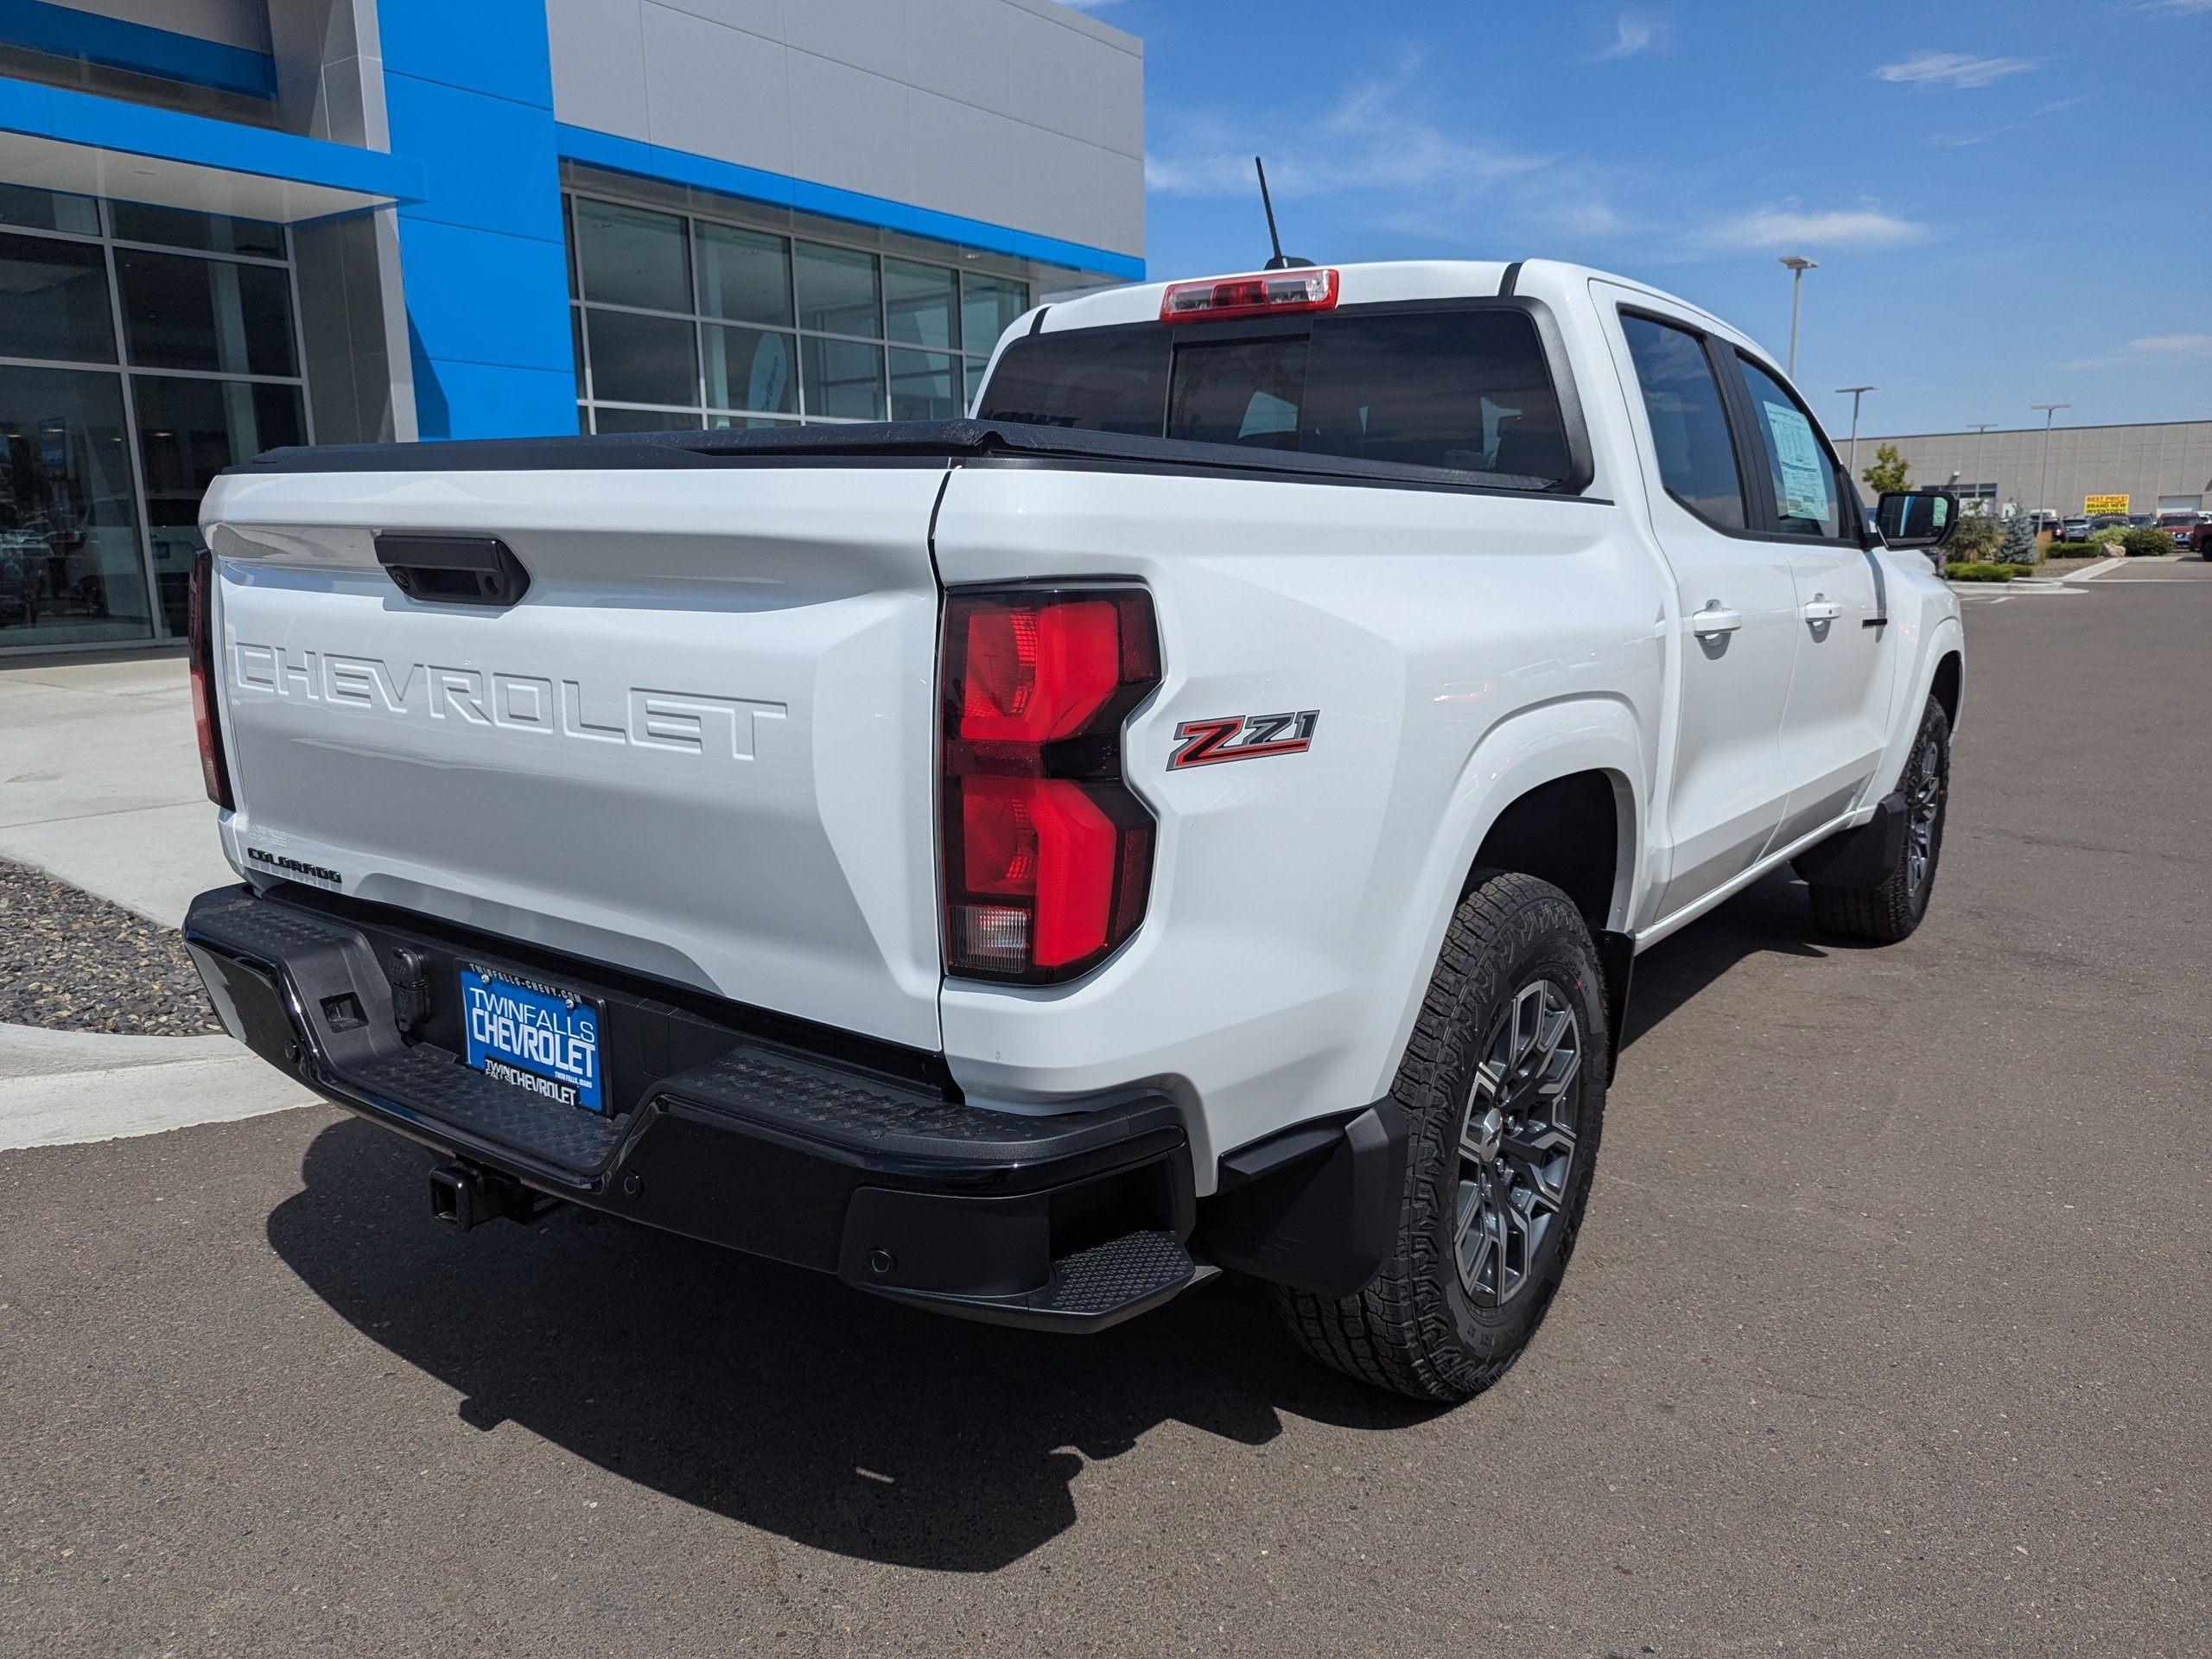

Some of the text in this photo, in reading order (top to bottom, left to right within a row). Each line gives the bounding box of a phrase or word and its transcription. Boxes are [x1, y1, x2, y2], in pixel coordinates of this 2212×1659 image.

[235, 641, 787, 760] CHEVROLET
[1166, 709, 1320, 772] Z71
[247, 847, 342, 883] COLORADO
[469, 963, 582, 1003] TWINFALLS-CHEVY.COM
[469, 987, 595, 1043] TWINFALLS
[472, 1007, 596, 1077] CHEVROLET
[485, 1059, 512, 1077] TWIN
[511, 1069, 576, 1106] CHEVROLET
[554, 1071, 567, 1080] TWIN
[579, 1078, 593, 1089] IDAHO
